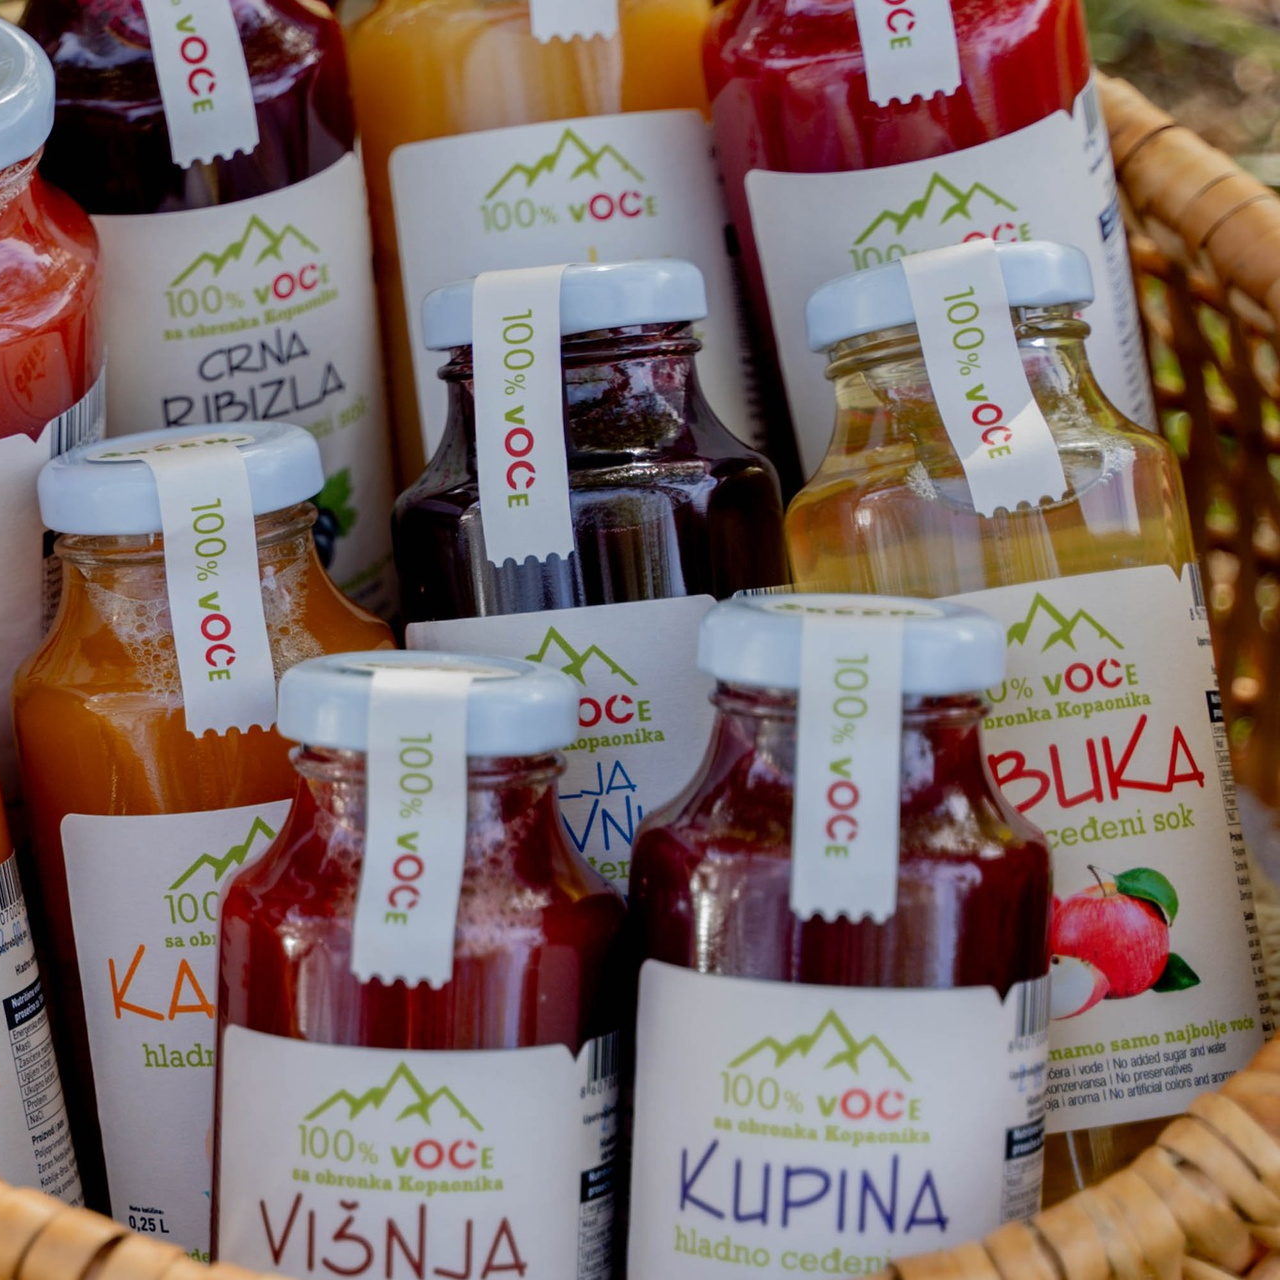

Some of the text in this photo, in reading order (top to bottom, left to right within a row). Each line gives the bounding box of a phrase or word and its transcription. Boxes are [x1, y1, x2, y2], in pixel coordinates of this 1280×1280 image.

[850, 243, 907, 270] 100
[165, 284, 246, 319] 100%
[502, 309, 535, 395] 100%
[944, 286, 984, 376] 100%
[197, 328, 310, 382] CRNA
[161, 361, 347, 428] RIBIZLA
[191, 498, 227, 581] 100%
[832, 654, 869, 744] 100%
[1055, 692, 1152, 719] Kopaonika
[399, 733, 434, 818] 100%
[988, 714, 1205, 814] BUKA
[1154, 803, 1195, 832] sok
[164, 891, 218, 924] 100
[165, 935, 185, 948] sa
[108, 944, 216, 1021] KA
[1110, 1033, 1161, 1052] samo
[1164, 1017, 1228, 1047] najbolje
[1078, 1060, 1104, 1078] vode
[1113, 1056, 1128, 1070] No
[1131, 1050, 1161, 1067] added
[1163, 1047, 1188, 1064] sugar
[1190, 1044, 1205, 1057] and
[1207, 1041, 1227, 1055] water
[1116, 1069, 1131, 1083] No
[1133, 1061, 1193, 1083] preservatives
[720, 1070, 804, 1114] 100%
[1068, 1091, 1100, 1107] aroma
[1109, 1086, 1125, 1099] No
[1127, 1080, 1163, 1098] artificial
[1165, 1075, 1193, 1091] colors
[1194, 1073, 1210, 1086] and
[298, 1124, 379, 1165] 100%
[679, 1138, 949, 1234] KUPINA
[129, 1215, 170, 1233] 0,25 L
[674, 1225, 771, 1268] hladno
